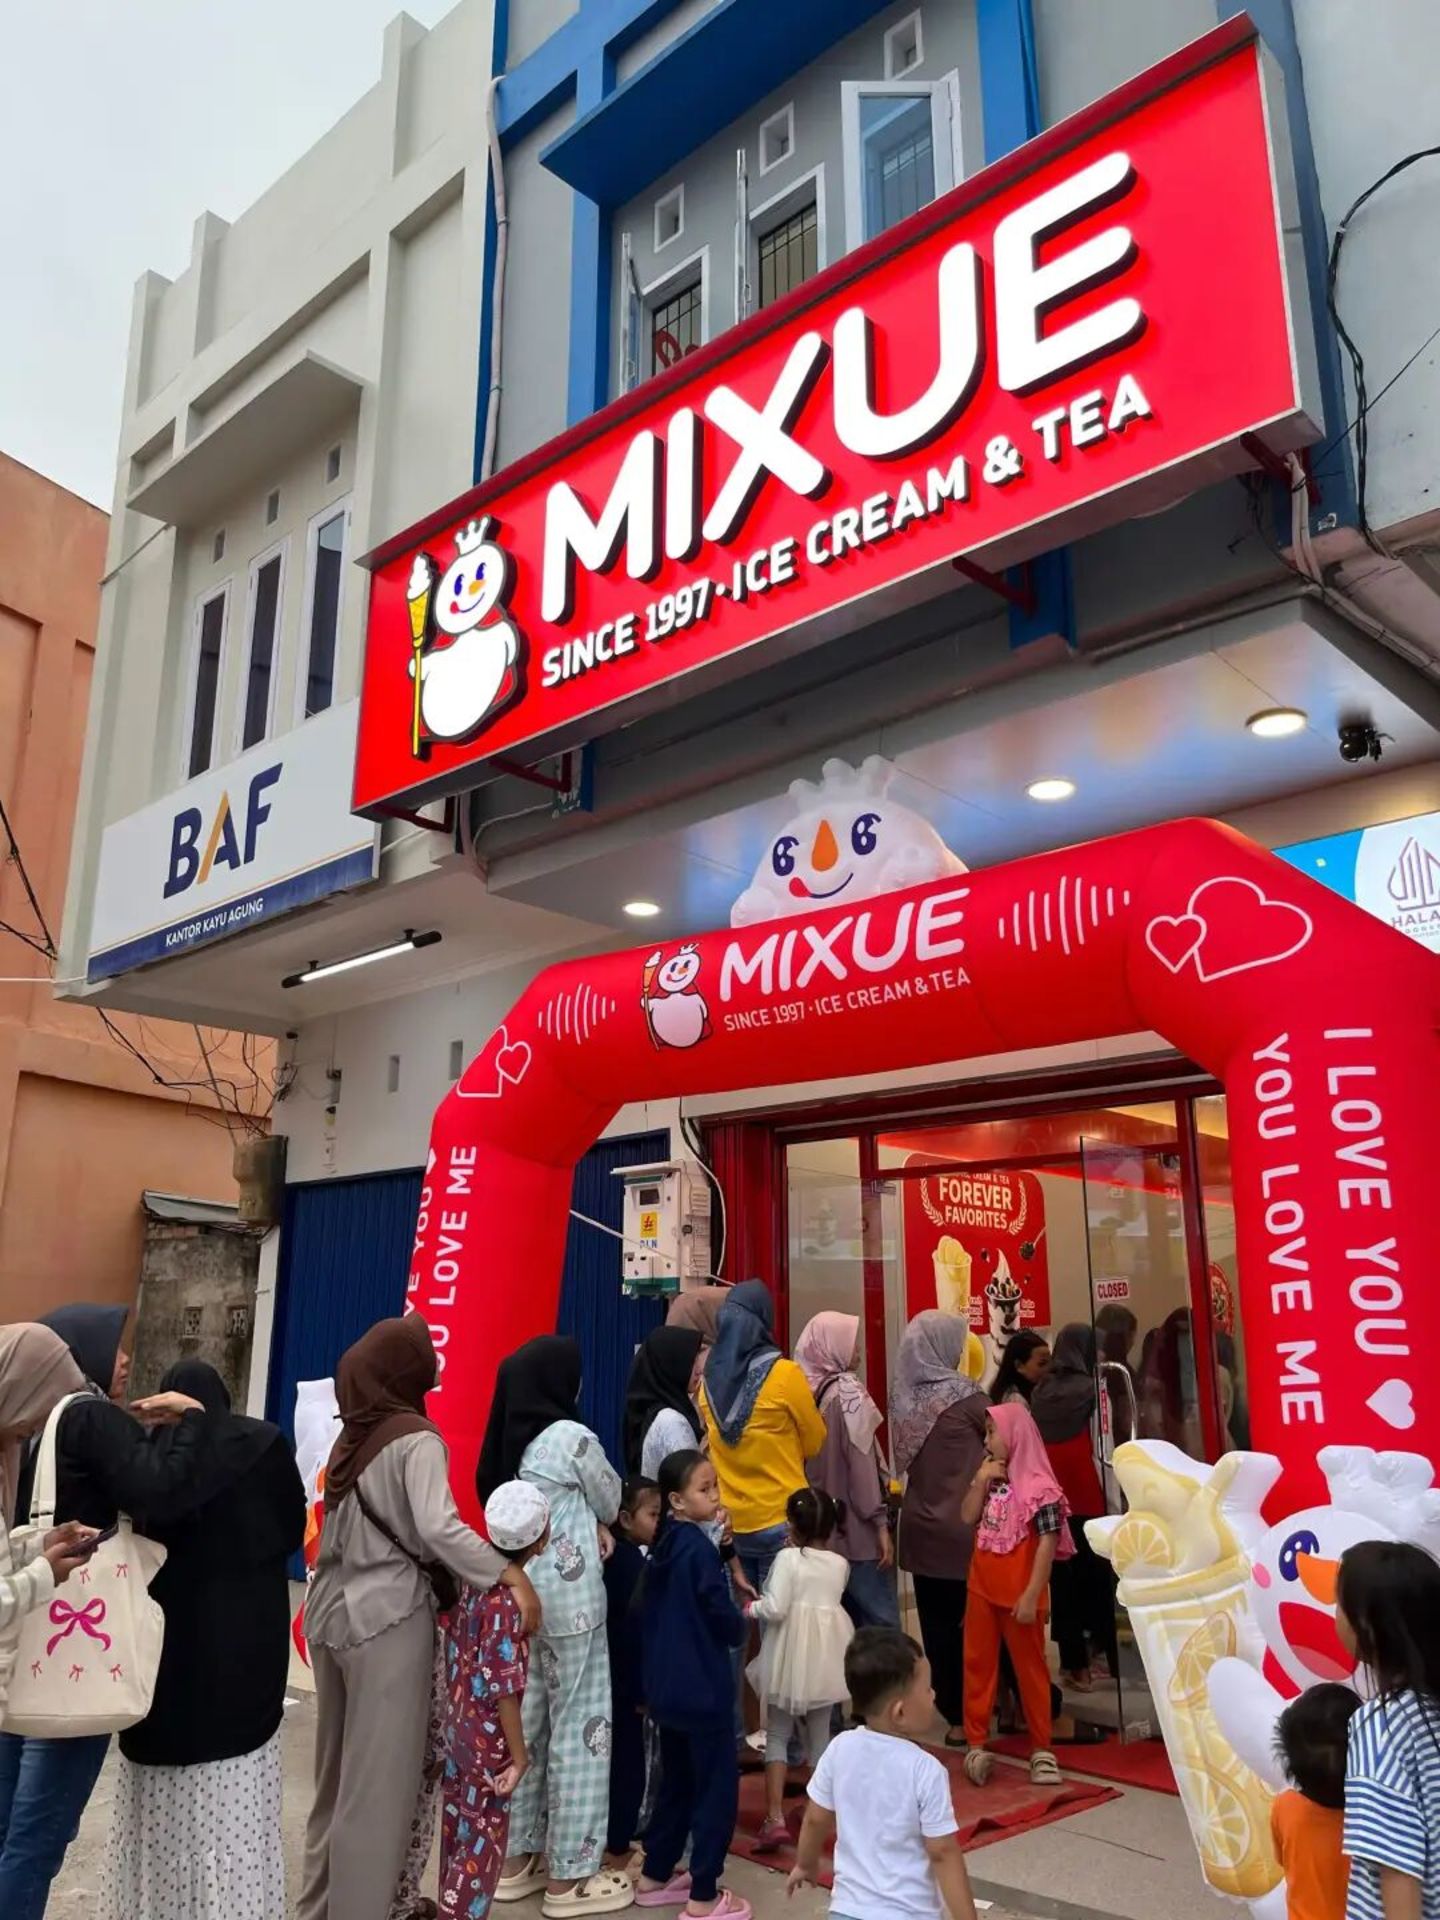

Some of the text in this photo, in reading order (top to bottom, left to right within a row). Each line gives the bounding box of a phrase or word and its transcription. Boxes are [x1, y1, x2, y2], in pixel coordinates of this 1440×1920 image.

[541, 152, 1144, 622] MIXUE
[542, 613, 637, 688] SINCE
[807, 456, 969, 565] CREAM
[983, 435, 1024, 485] &
[1032, 374, 1152, 461] TEA
[163, 762, 283, 899] BAF
[165, 898, 263, 947] KANTOR KAYU AGUNG
[720, 888, 970, 1001] MIXUE
[723, 1008, 771, 1031] SINCE
[847, 979, 912, 1010] CREAM
[914, 976, 929, 995] &
[929, 967, 971, 991] TEA
[446, 1145, 477, 1194] ME
[939, 1177, 1013, 1211] FOREVER
[945, 1205, 1007, 1229] FAVORITES
[1324, 1028, 1410, 1356] I LOVE YOU
[429, 1210, 467, 1306] LOVE
[1252, 1032, 1324, 1425] YOU LOVE ME
[1097, 1282, 1128, 1299] CLOSED
